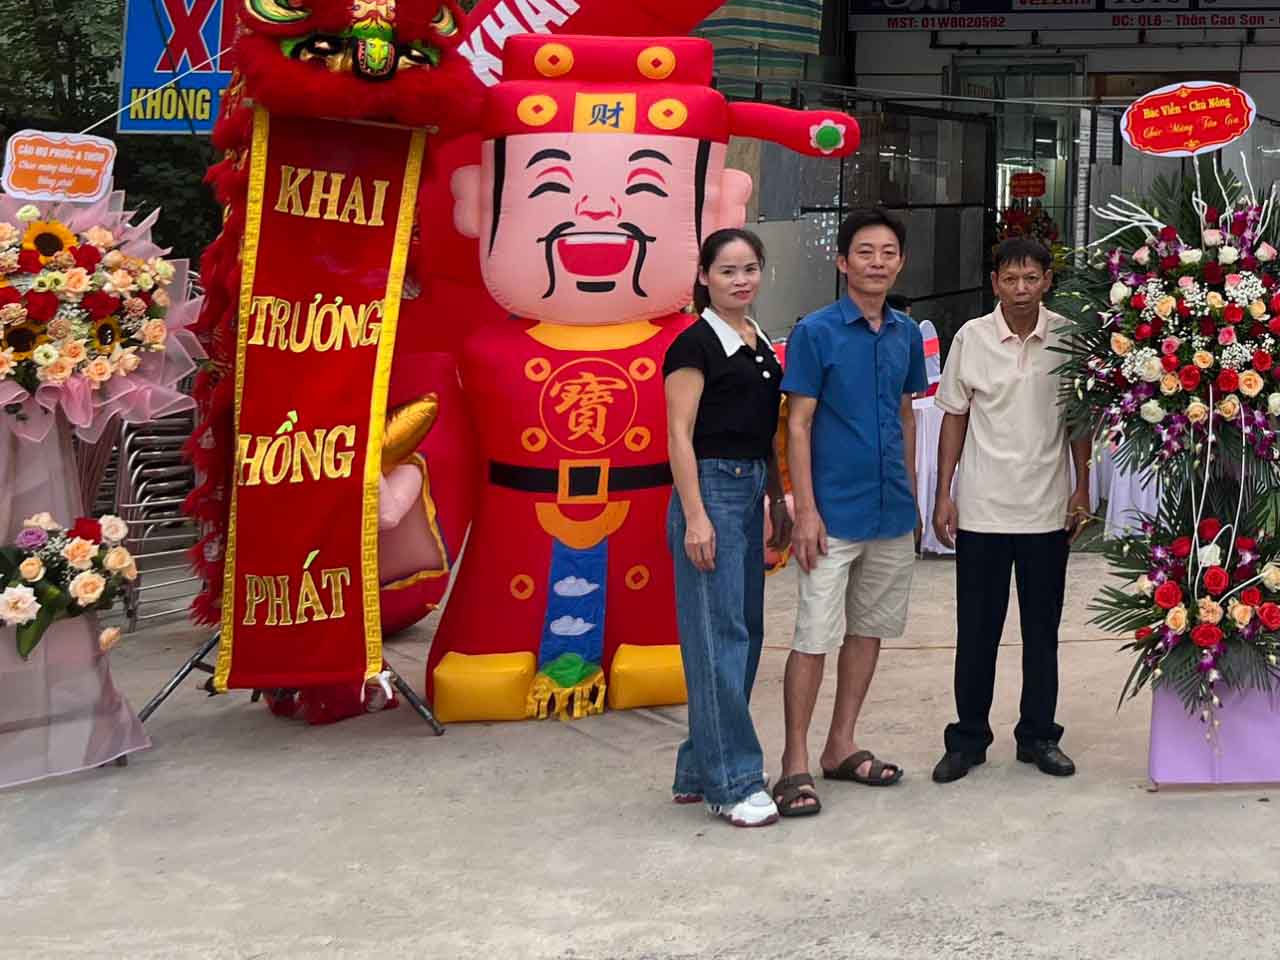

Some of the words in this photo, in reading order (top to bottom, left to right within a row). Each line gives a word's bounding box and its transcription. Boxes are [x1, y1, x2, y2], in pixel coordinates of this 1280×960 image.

[887, 16, 918, 29] MST:
[130, 83, 211, 121] KHÔNG
[588, 100, 625, 129] 财
[275, 164, 390, 227] KHAI
[238, 410, 357, 486] HỒNG
[242, 549, 351, 628] PHÁT
